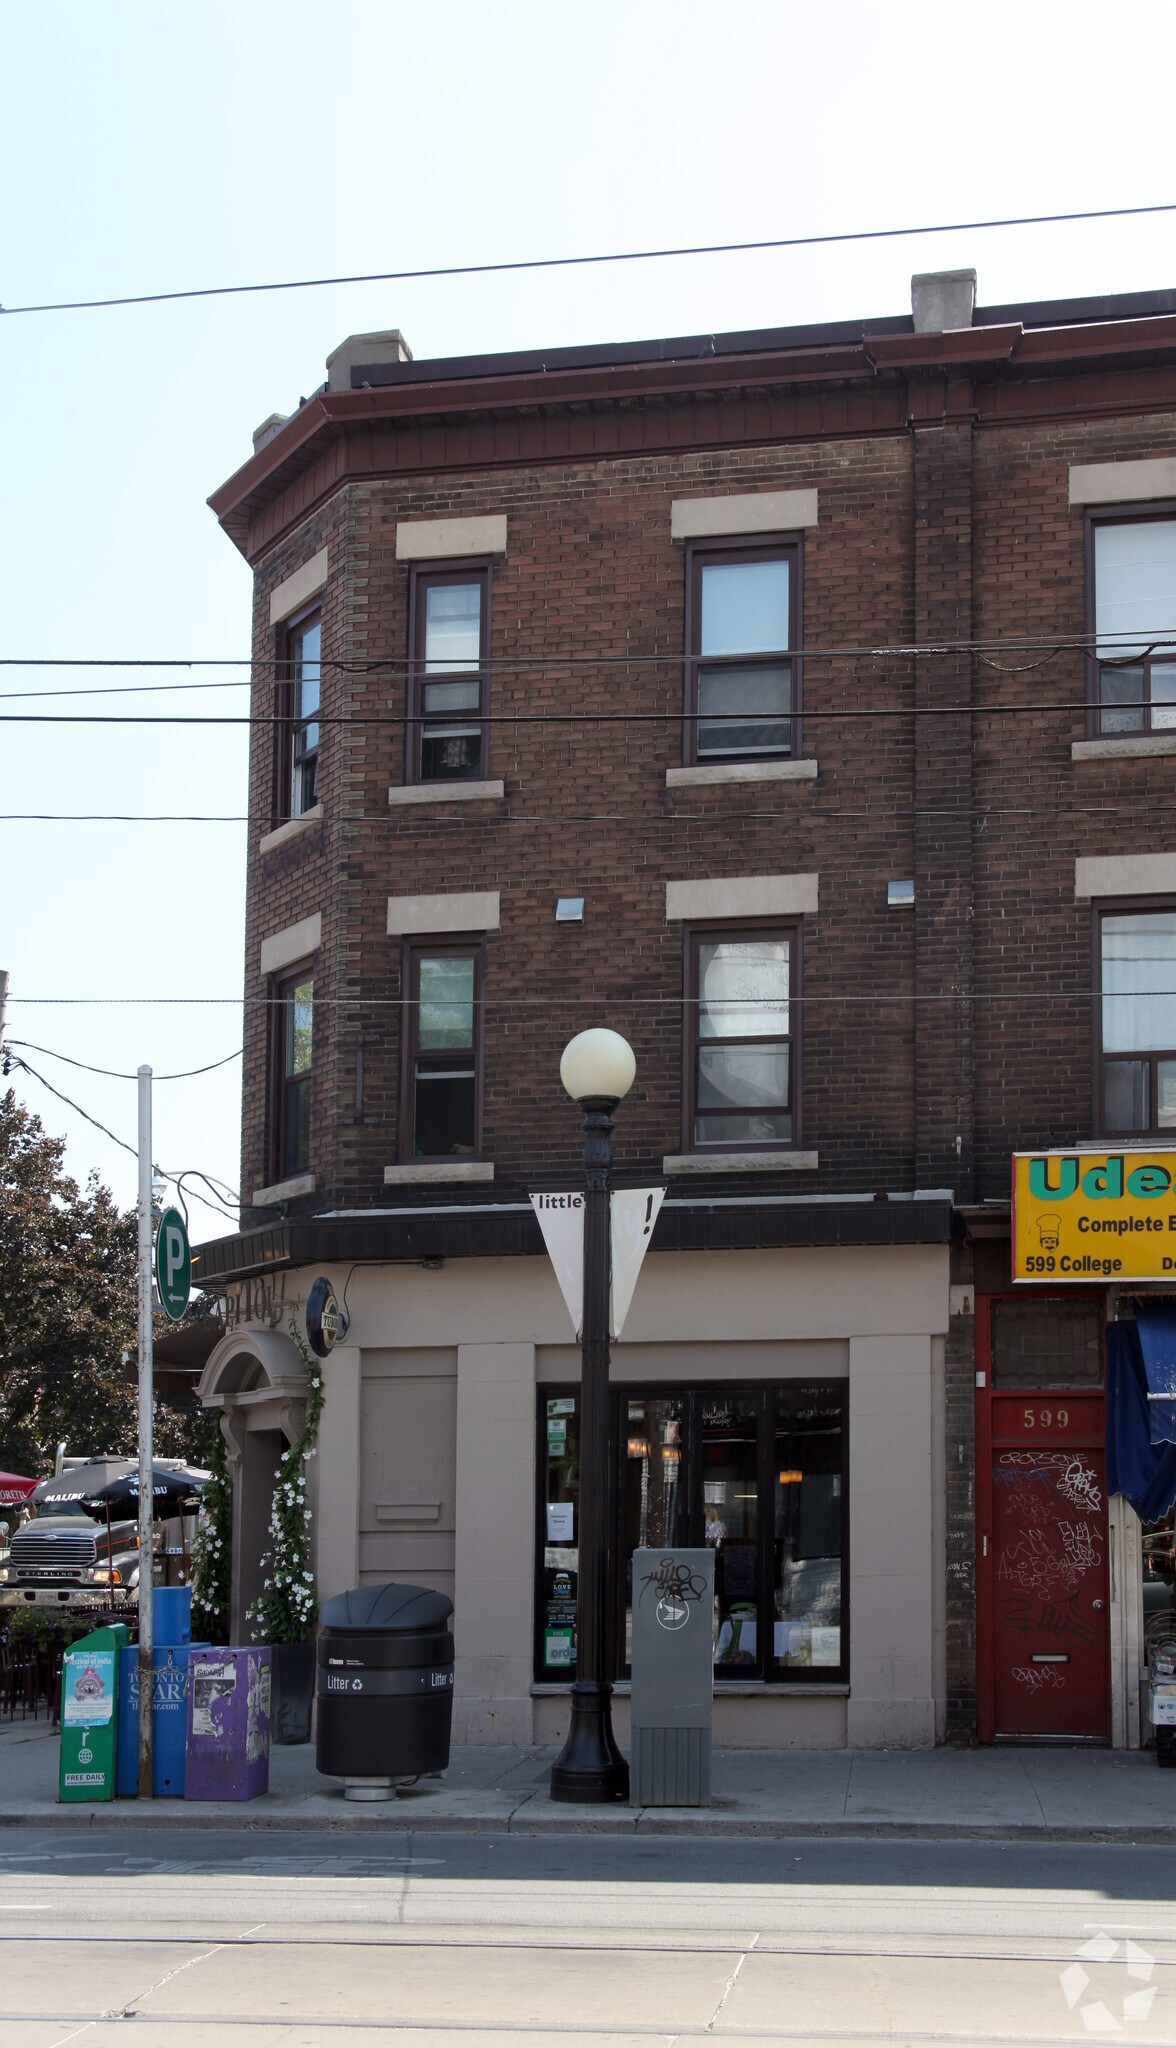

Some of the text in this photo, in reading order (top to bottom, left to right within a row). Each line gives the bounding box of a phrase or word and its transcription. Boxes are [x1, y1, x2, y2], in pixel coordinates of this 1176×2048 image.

[1029, 1156, 1176, 1201] Ude
[538, 1194, 582, 1209] little
[1077, 1216, 1164, 1236] Complete
[166, 1226, 185, 1287] P
[1025, 1255, 1176, 1275] 599 College D
[1023, 1409, 1069, 1428] 599
[44, 1492, 86, 1502] MALIBU
[129, 1485, 169, 1497] MIBU
[128, 1672, 185, 1683] TONTO
[327, 1675, 350, 1690] Litter
[431, 1672, 447, 1687] Litter
[130, 1683, 182, 1700] SAR
